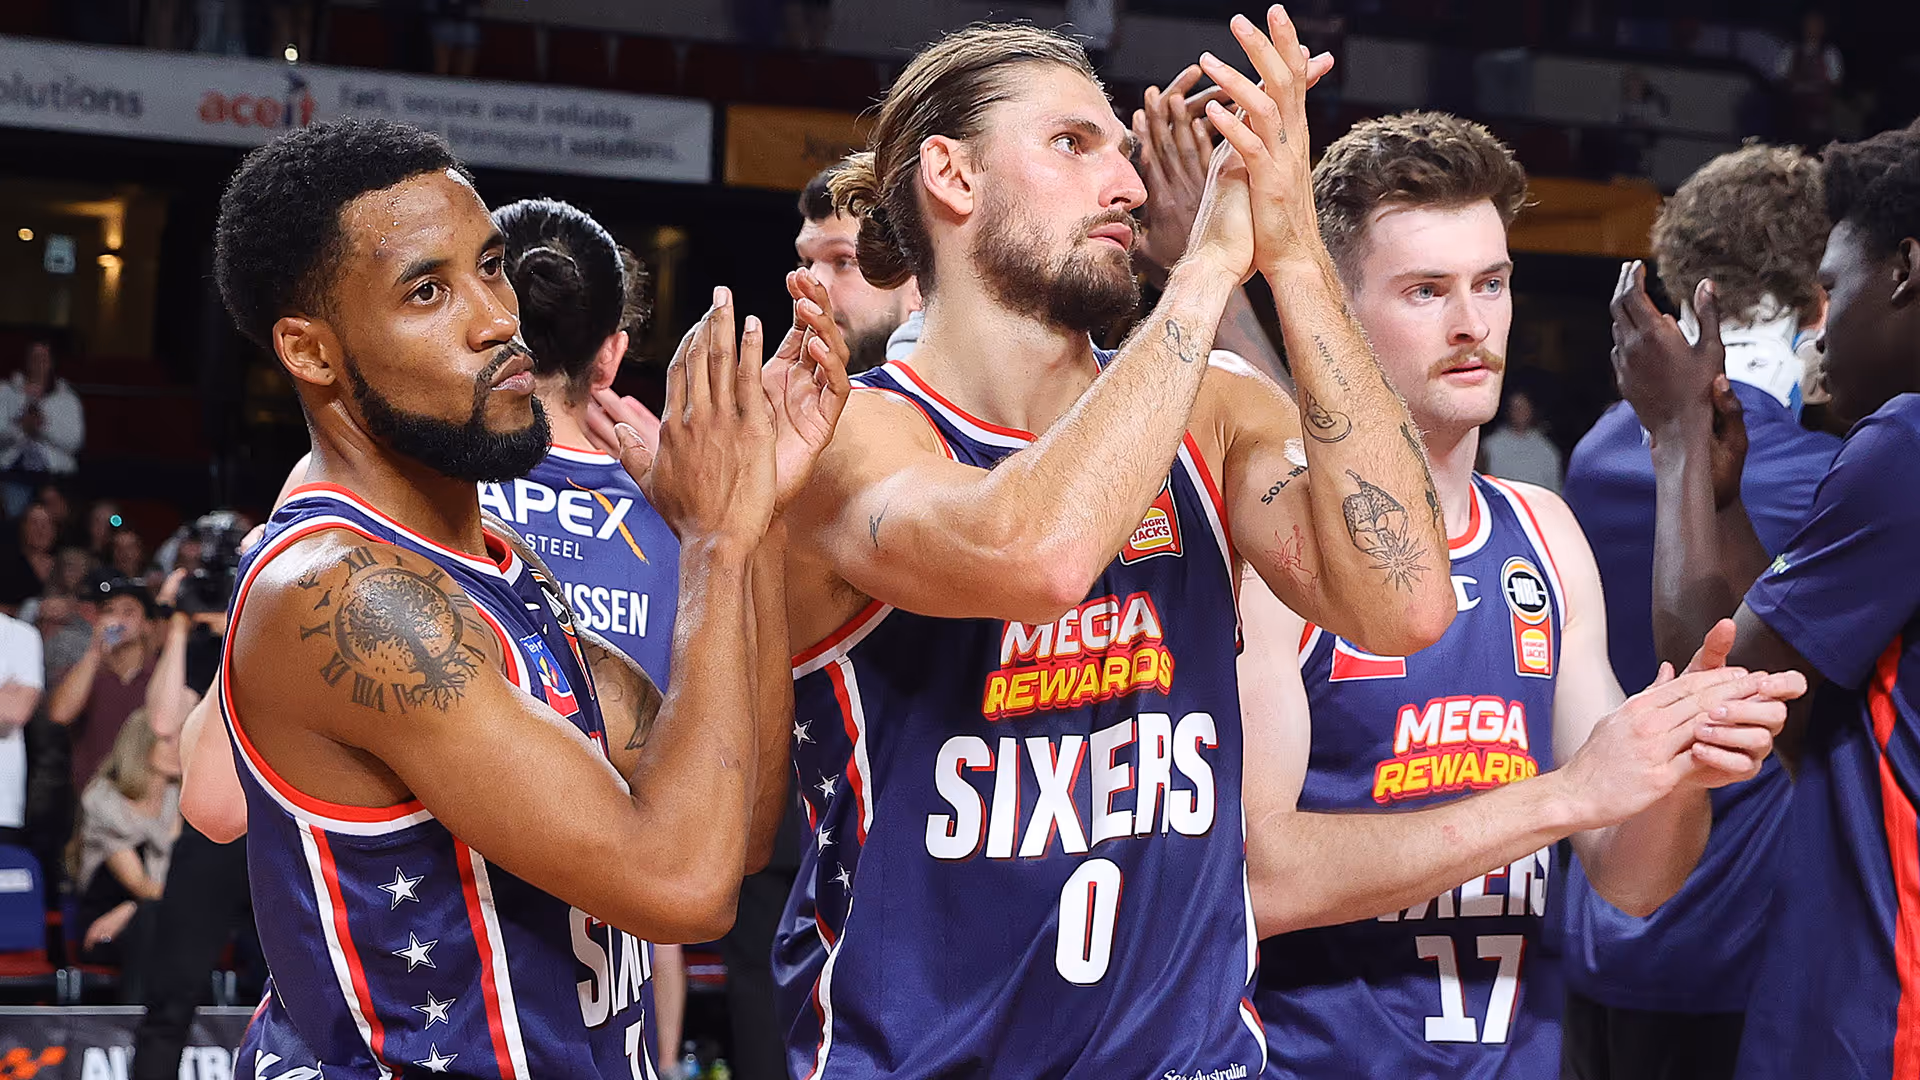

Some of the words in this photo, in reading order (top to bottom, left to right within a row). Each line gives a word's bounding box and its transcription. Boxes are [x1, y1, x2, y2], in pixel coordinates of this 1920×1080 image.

[478, 477, 644, 554] APEX
[525, 533, 584, 561] STEEL
[558, 582, 649, 638] SSEN
[1000, 596, 1163, 666] MEGA
[983, 648, 1171, 714] REWARDS
[1393, 700, 1529, 754] MEGA
[925, 711, 1217, 861] SIXERS
[1055, 858, 1123, 986] 0
[1415, 934, 1527, 1044] 17
